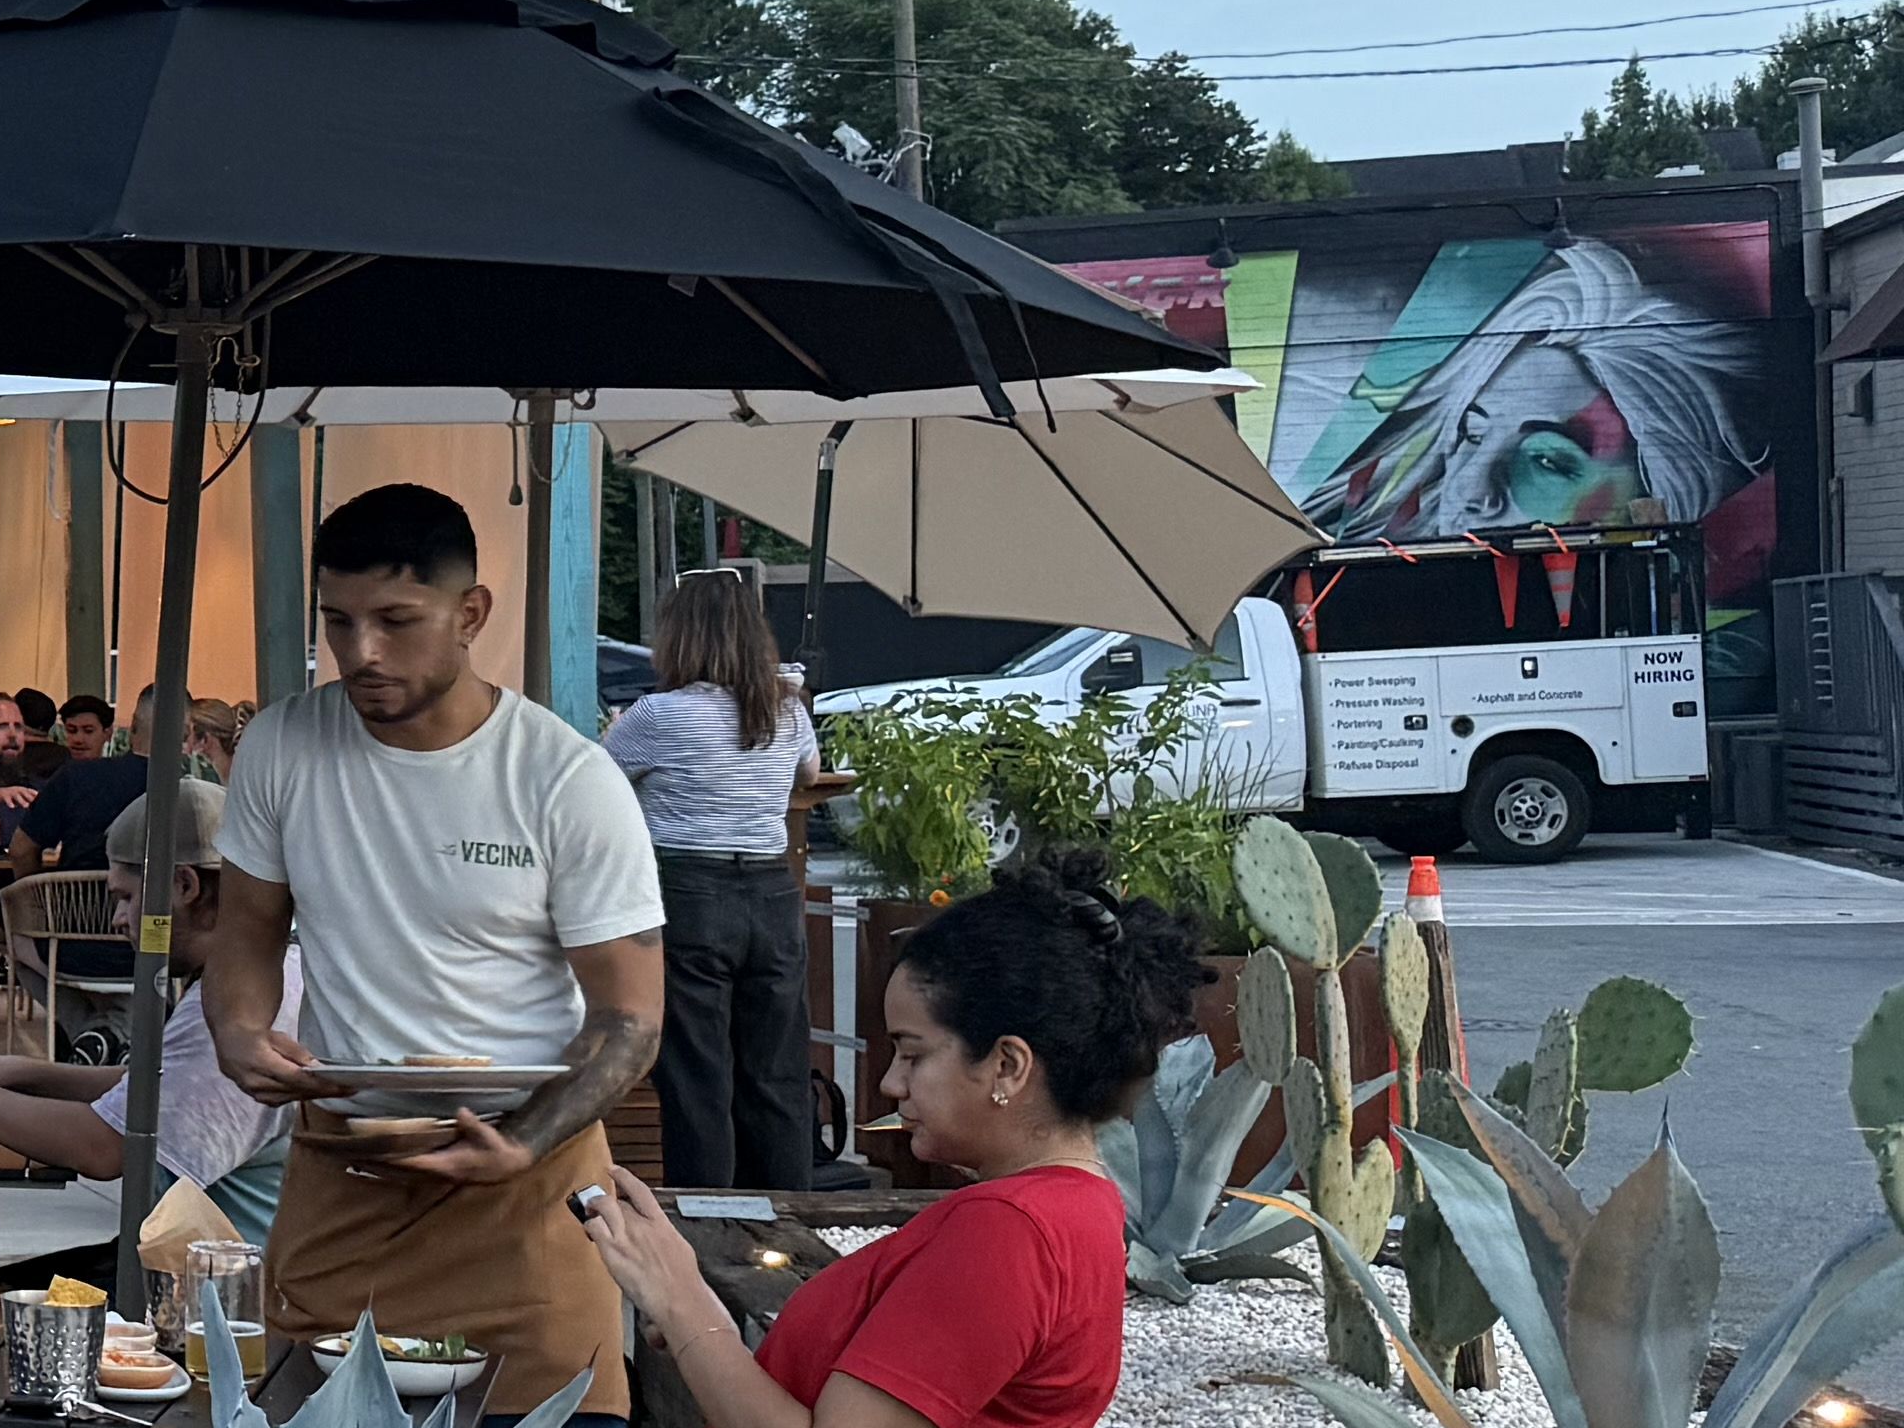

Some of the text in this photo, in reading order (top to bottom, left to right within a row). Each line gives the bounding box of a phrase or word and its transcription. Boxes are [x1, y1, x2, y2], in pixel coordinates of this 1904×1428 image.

[1644, 650, 1683, 665] NOW
[1334, 676, 1416, 689] Power Sweeping
[1634, 669, 1695, 684] HIRING
[1335, 696, 1425, 709] Pressure Washing
[1477, 690, 1583, 704] Asphalt and Concrete
[1337, 719, 1383, 730] Portering
[1338, 757, 1419, 771] Refuse Disposal
[461, 839, 535, 868] VECINA
